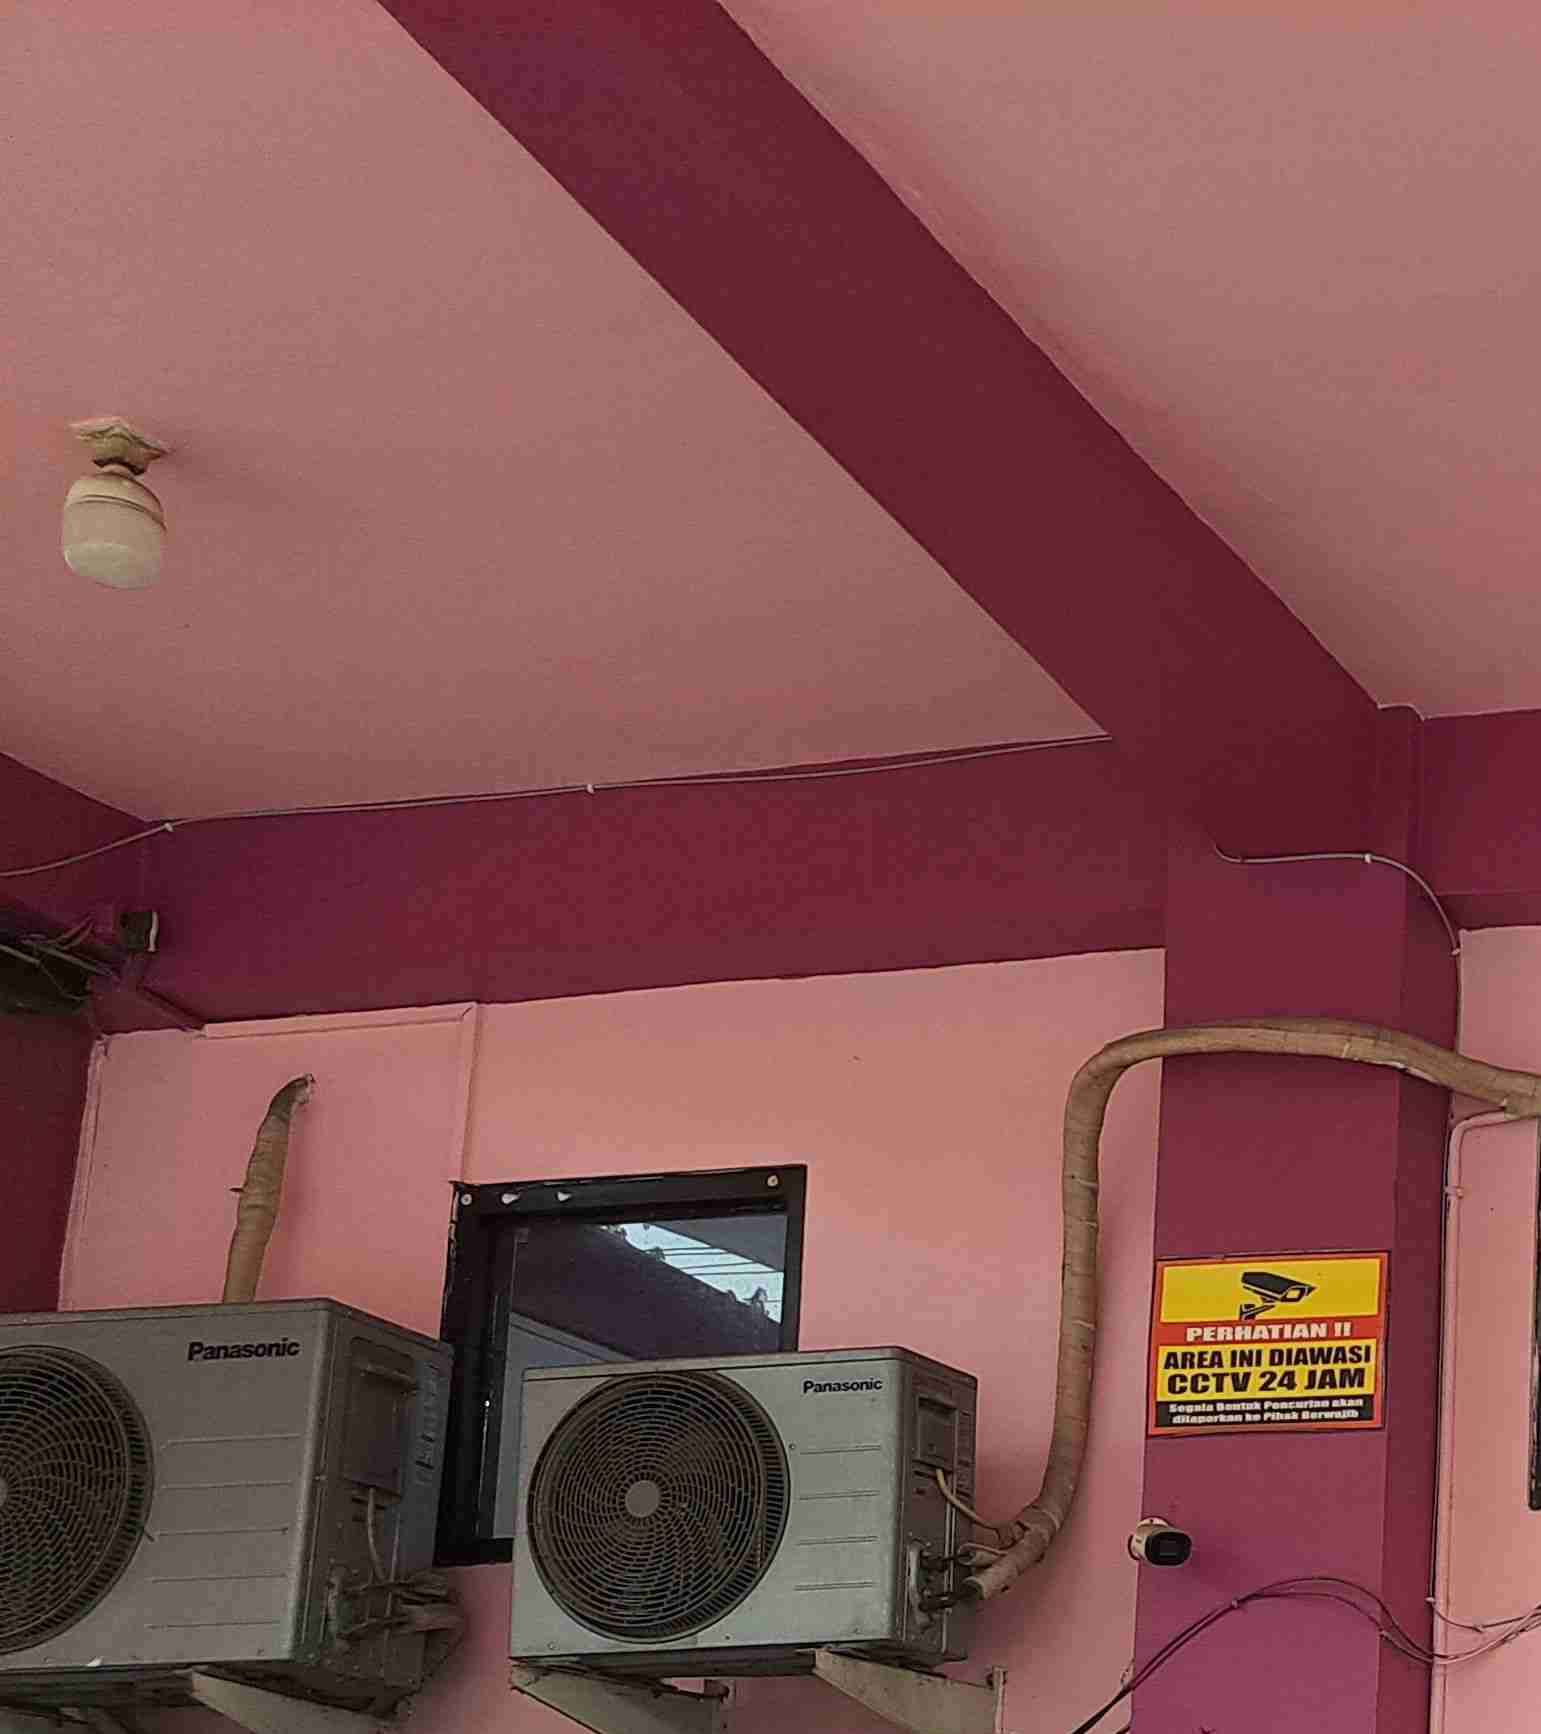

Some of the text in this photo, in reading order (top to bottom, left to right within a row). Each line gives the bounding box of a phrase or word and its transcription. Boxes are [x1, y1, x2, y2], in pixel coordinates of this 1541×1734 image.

[1186, 1324, 1327, 1342] PERHATIAN
[187, 1337, 300, 1361] Panasonic
[1163, 1345, 1371, 1370] AREA INI DIAWASI
[803, 1377, 883, 1394] Panasonic
[1167, 1368, 1365, 1395] CCTV 24 JAM
